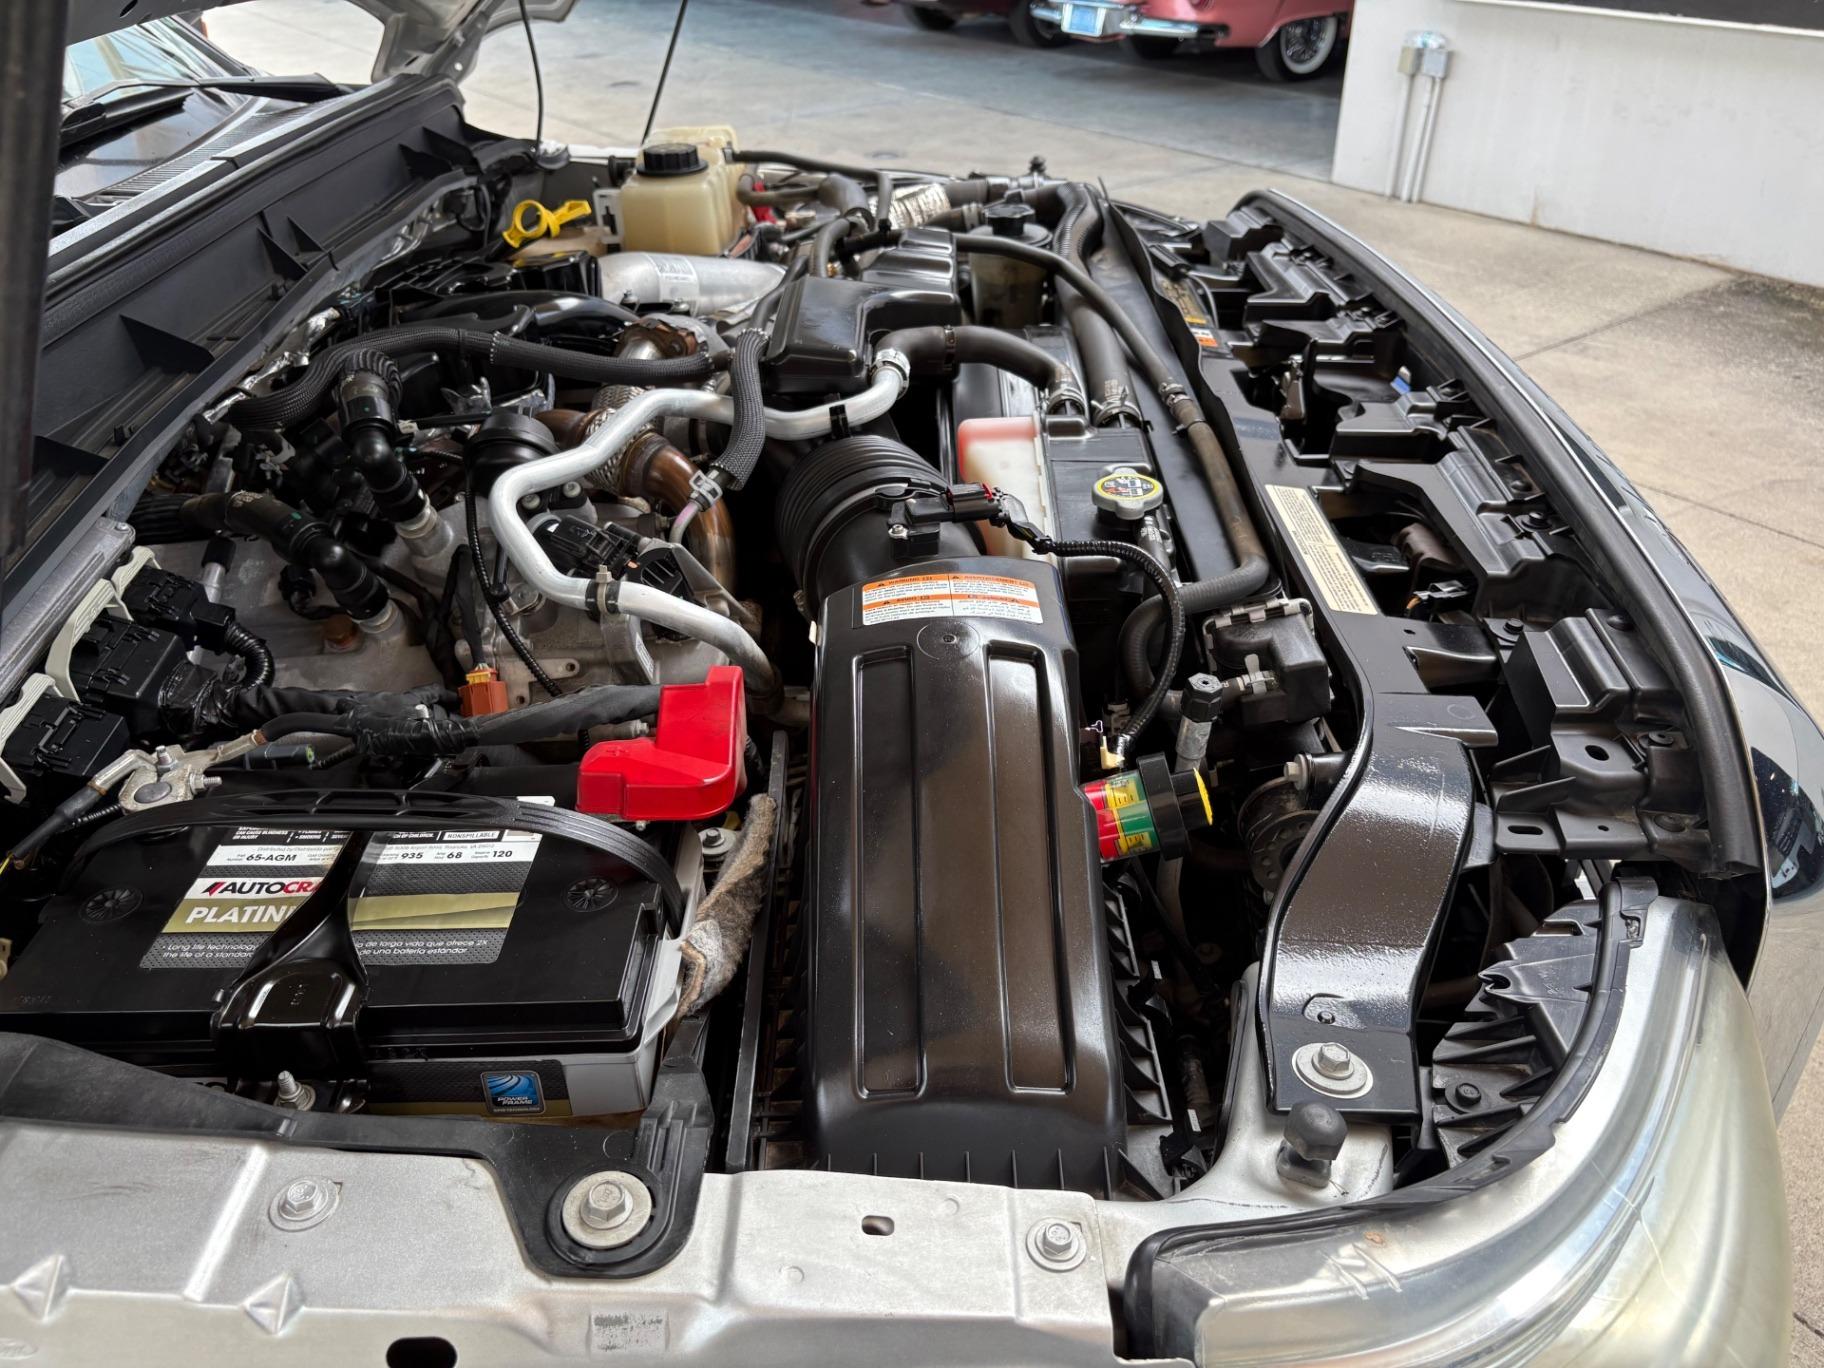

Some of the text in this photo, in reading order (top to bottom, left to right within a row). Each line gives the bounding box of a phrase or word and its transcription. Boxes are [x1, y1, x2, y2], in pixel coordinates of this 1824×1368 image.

[246, 854, 297, 862] 65-AGM
[401, 852, 424, 860] 935
[446, 851, 463, 859] 68
[492, 850, 513, 858] 120
[206, 943, 260, 951] technology
[380, 940, 403, 948] larga
[446, 939, 475, 947] ofrece
